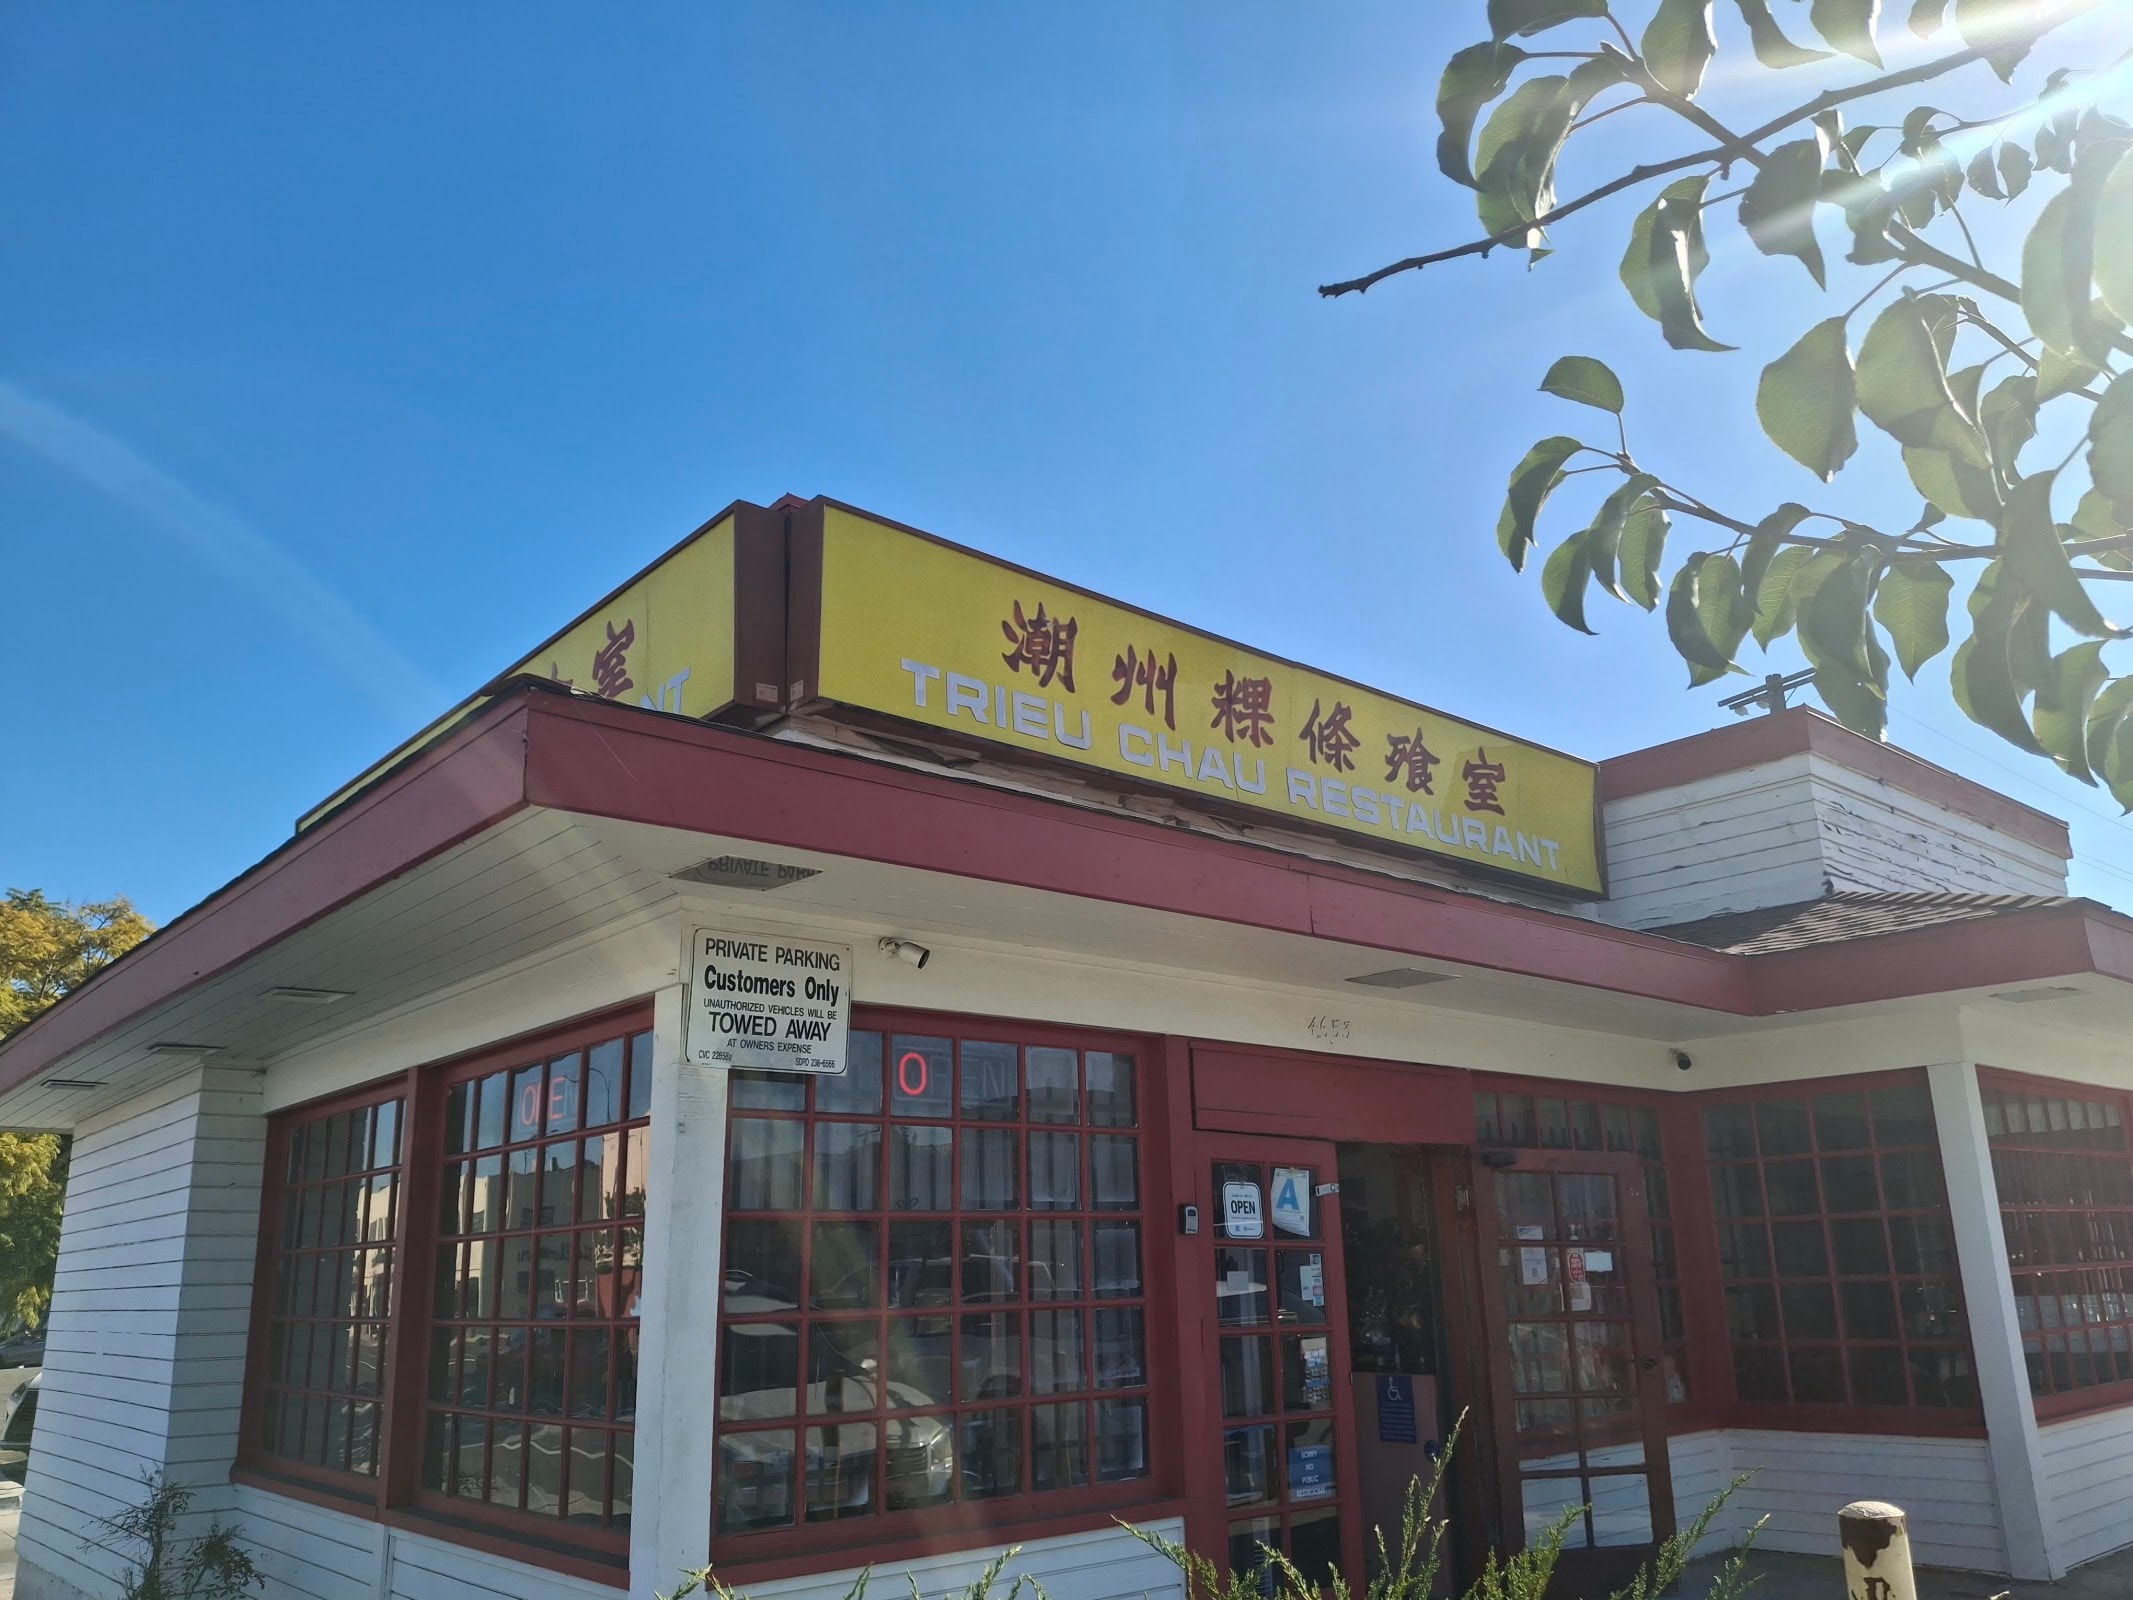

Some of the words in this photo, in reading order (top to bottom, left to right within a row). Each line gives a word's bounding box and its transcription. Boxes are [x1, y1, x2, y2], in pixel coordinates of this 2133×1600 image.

[900, 657, 1092, 750] TRIEU
[1118, 722, 1266, 795] CHAU
[1286, 766, 1560, 871] RESTAURANT
[705, 938, 768, 962] PRIVATE
[775, 947, 840, 972] PARKING
[704, 965, 796, 998] Customers
[804, 976, 839, 1007] Only
[703, 998, 765, 1013] UNAUTHORIZED
[768, 1004, 805, 1017] VEHICLES
[807, 1008, 825, 1019] WILL
[827, 1010, 837, 1020] BE
[709, 1011, 777, 1037] TOWED
[785, 1019, 832, 1042] AWAY
[698, 1050, 710, 1060] CVC
[726, 1038, 737, 1048] AT
[740, 1039, 774, 1051] OWNERS
[777, 1042, 812, 1054] EXPENSE
[1230, 1200, 1256, 1215] OPEN
[1275, 1178, 1300, 1211] A
